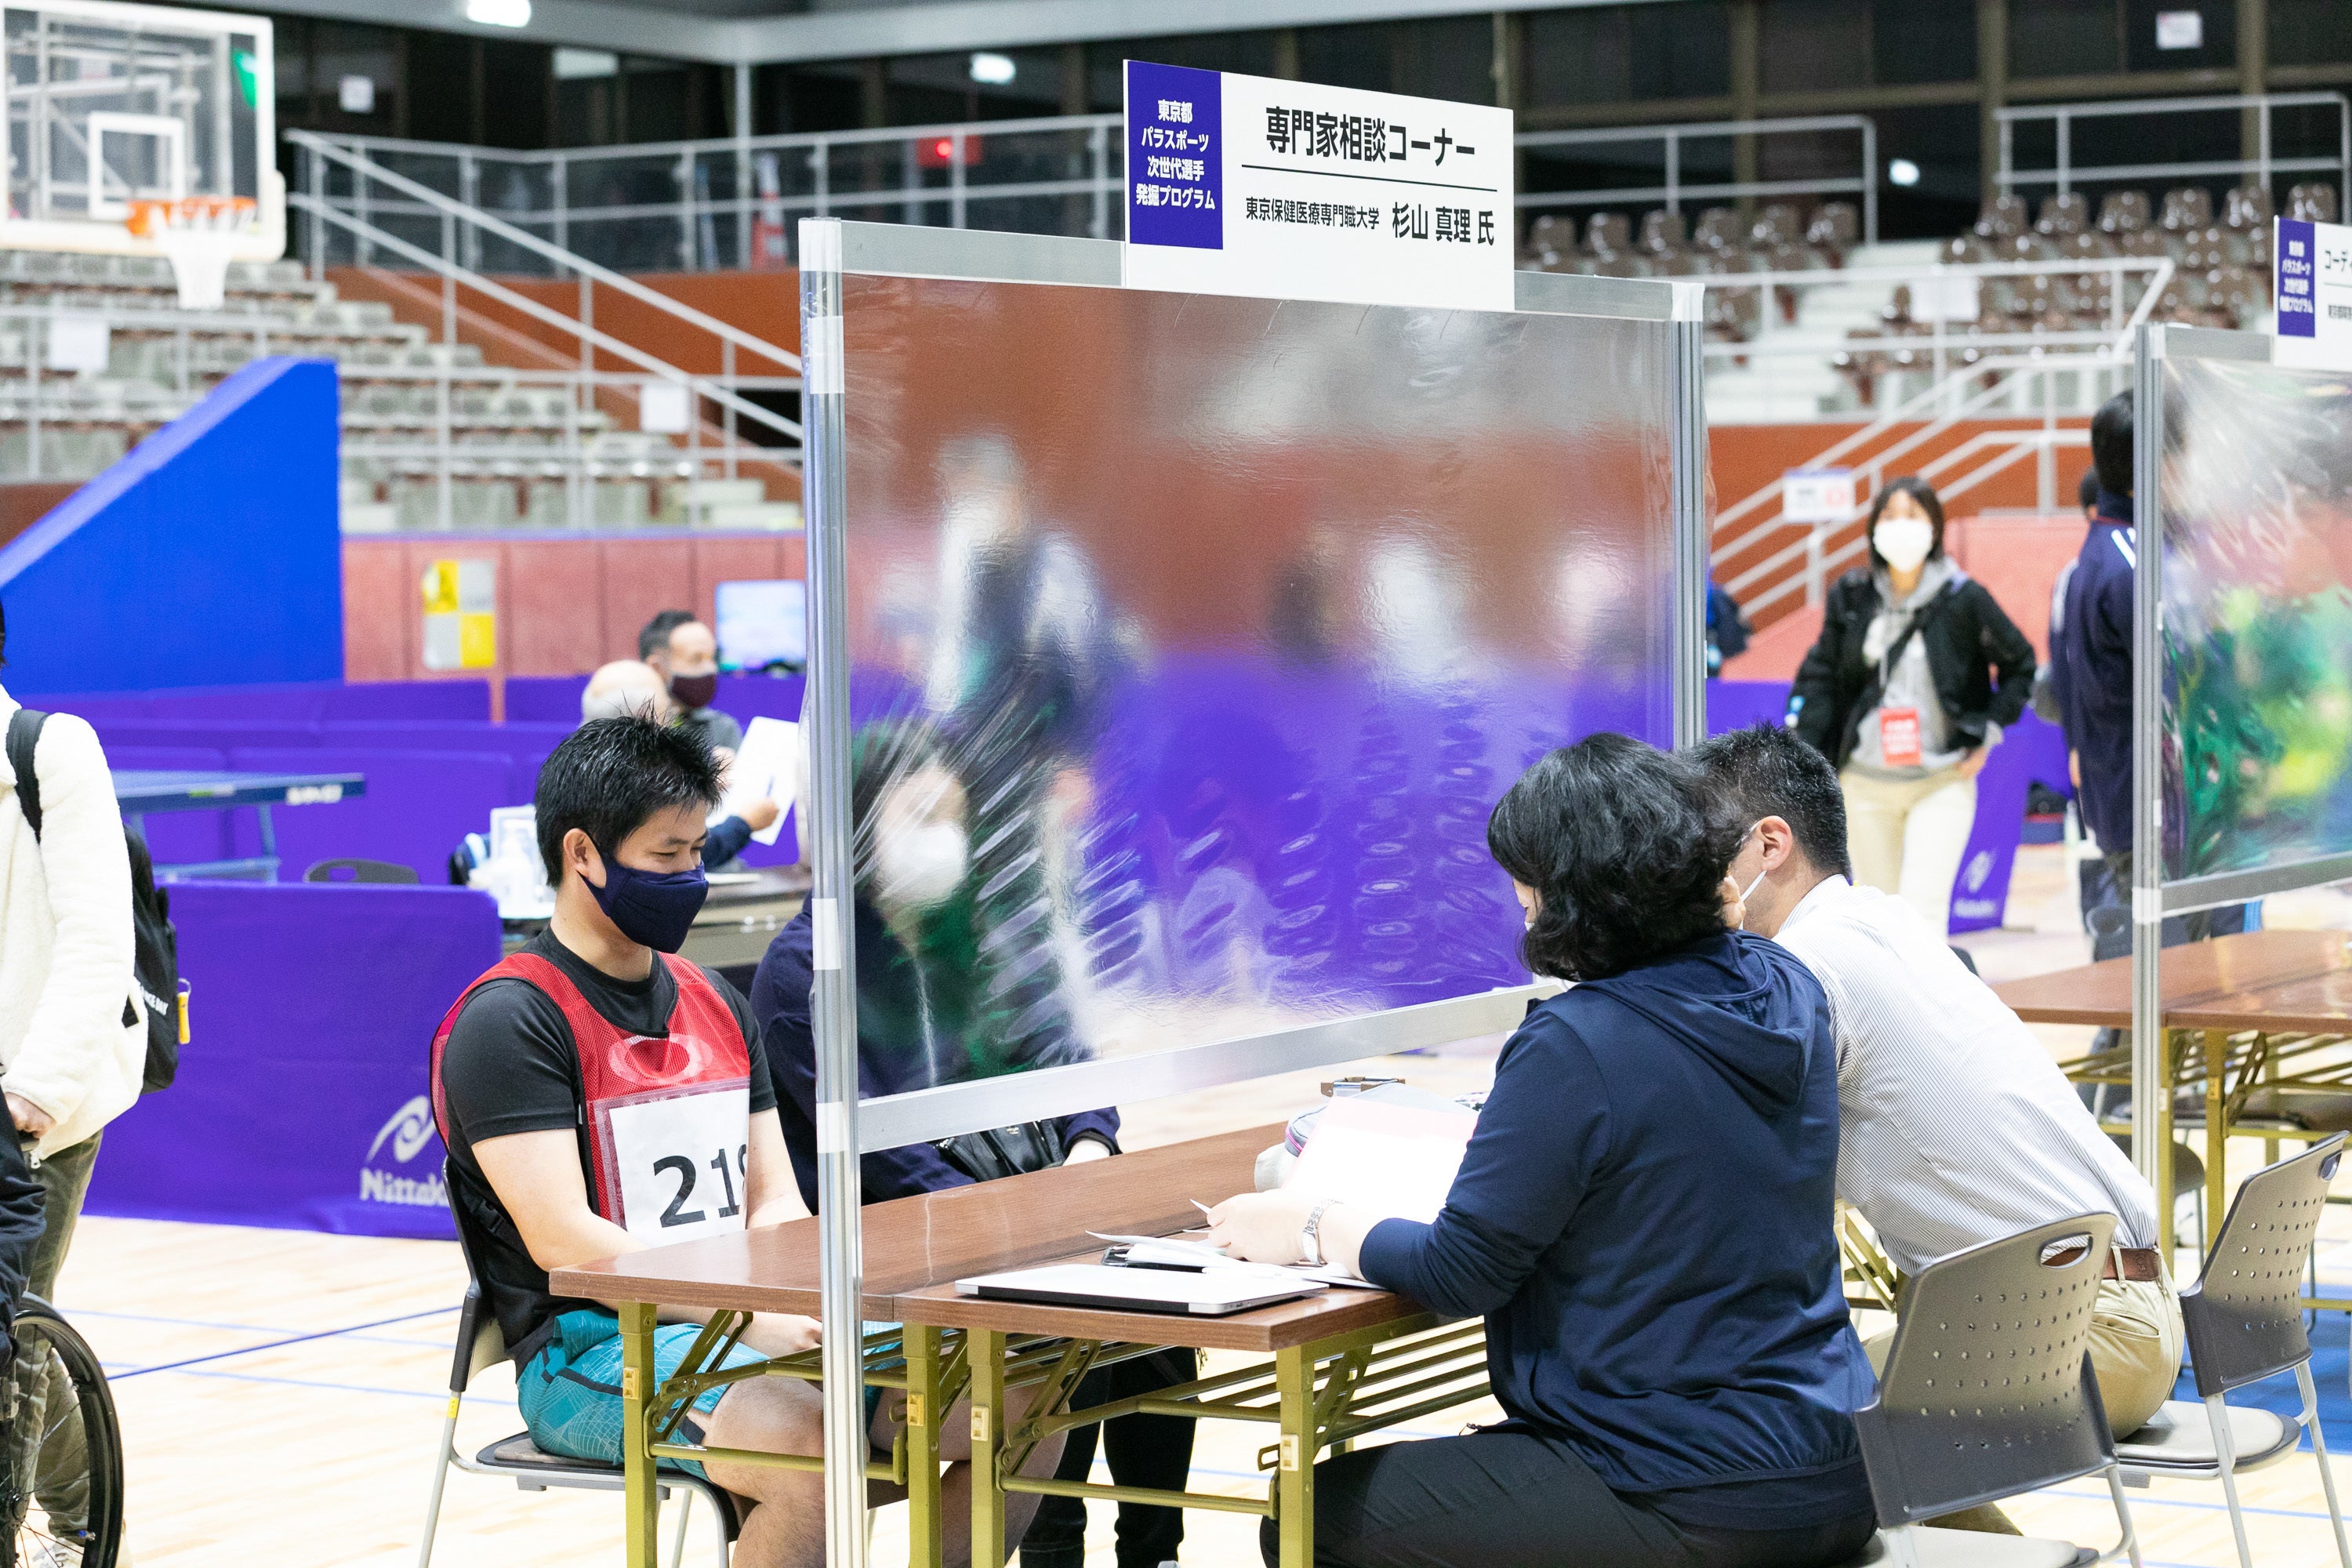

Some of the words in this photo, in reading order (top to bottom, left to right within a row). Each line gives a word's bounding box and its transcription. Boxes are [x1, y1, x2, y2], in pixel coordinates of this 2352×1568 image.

[1157, 99, 1193, 124] 東京都
[1141, 127, 1209, 153] パラスポーツ
[1265, 106, 1475, 167] 専門家相談コーナー
[1147, 155, 1205, 182] 次世代選手
[1135, 183, 1216, 210] 発掘プログラム
[1246, 196, 1380, 230] 東京保健医療専門職大学
[1392, 201, 1428, 240] 杉山
[1436, 205, 1471, 243] 真理
[1477, 210, 1494, 246] 氏
[2325, 249, 2352, 272] コーデ
[359, 1167, 449, 1207] Nittak
